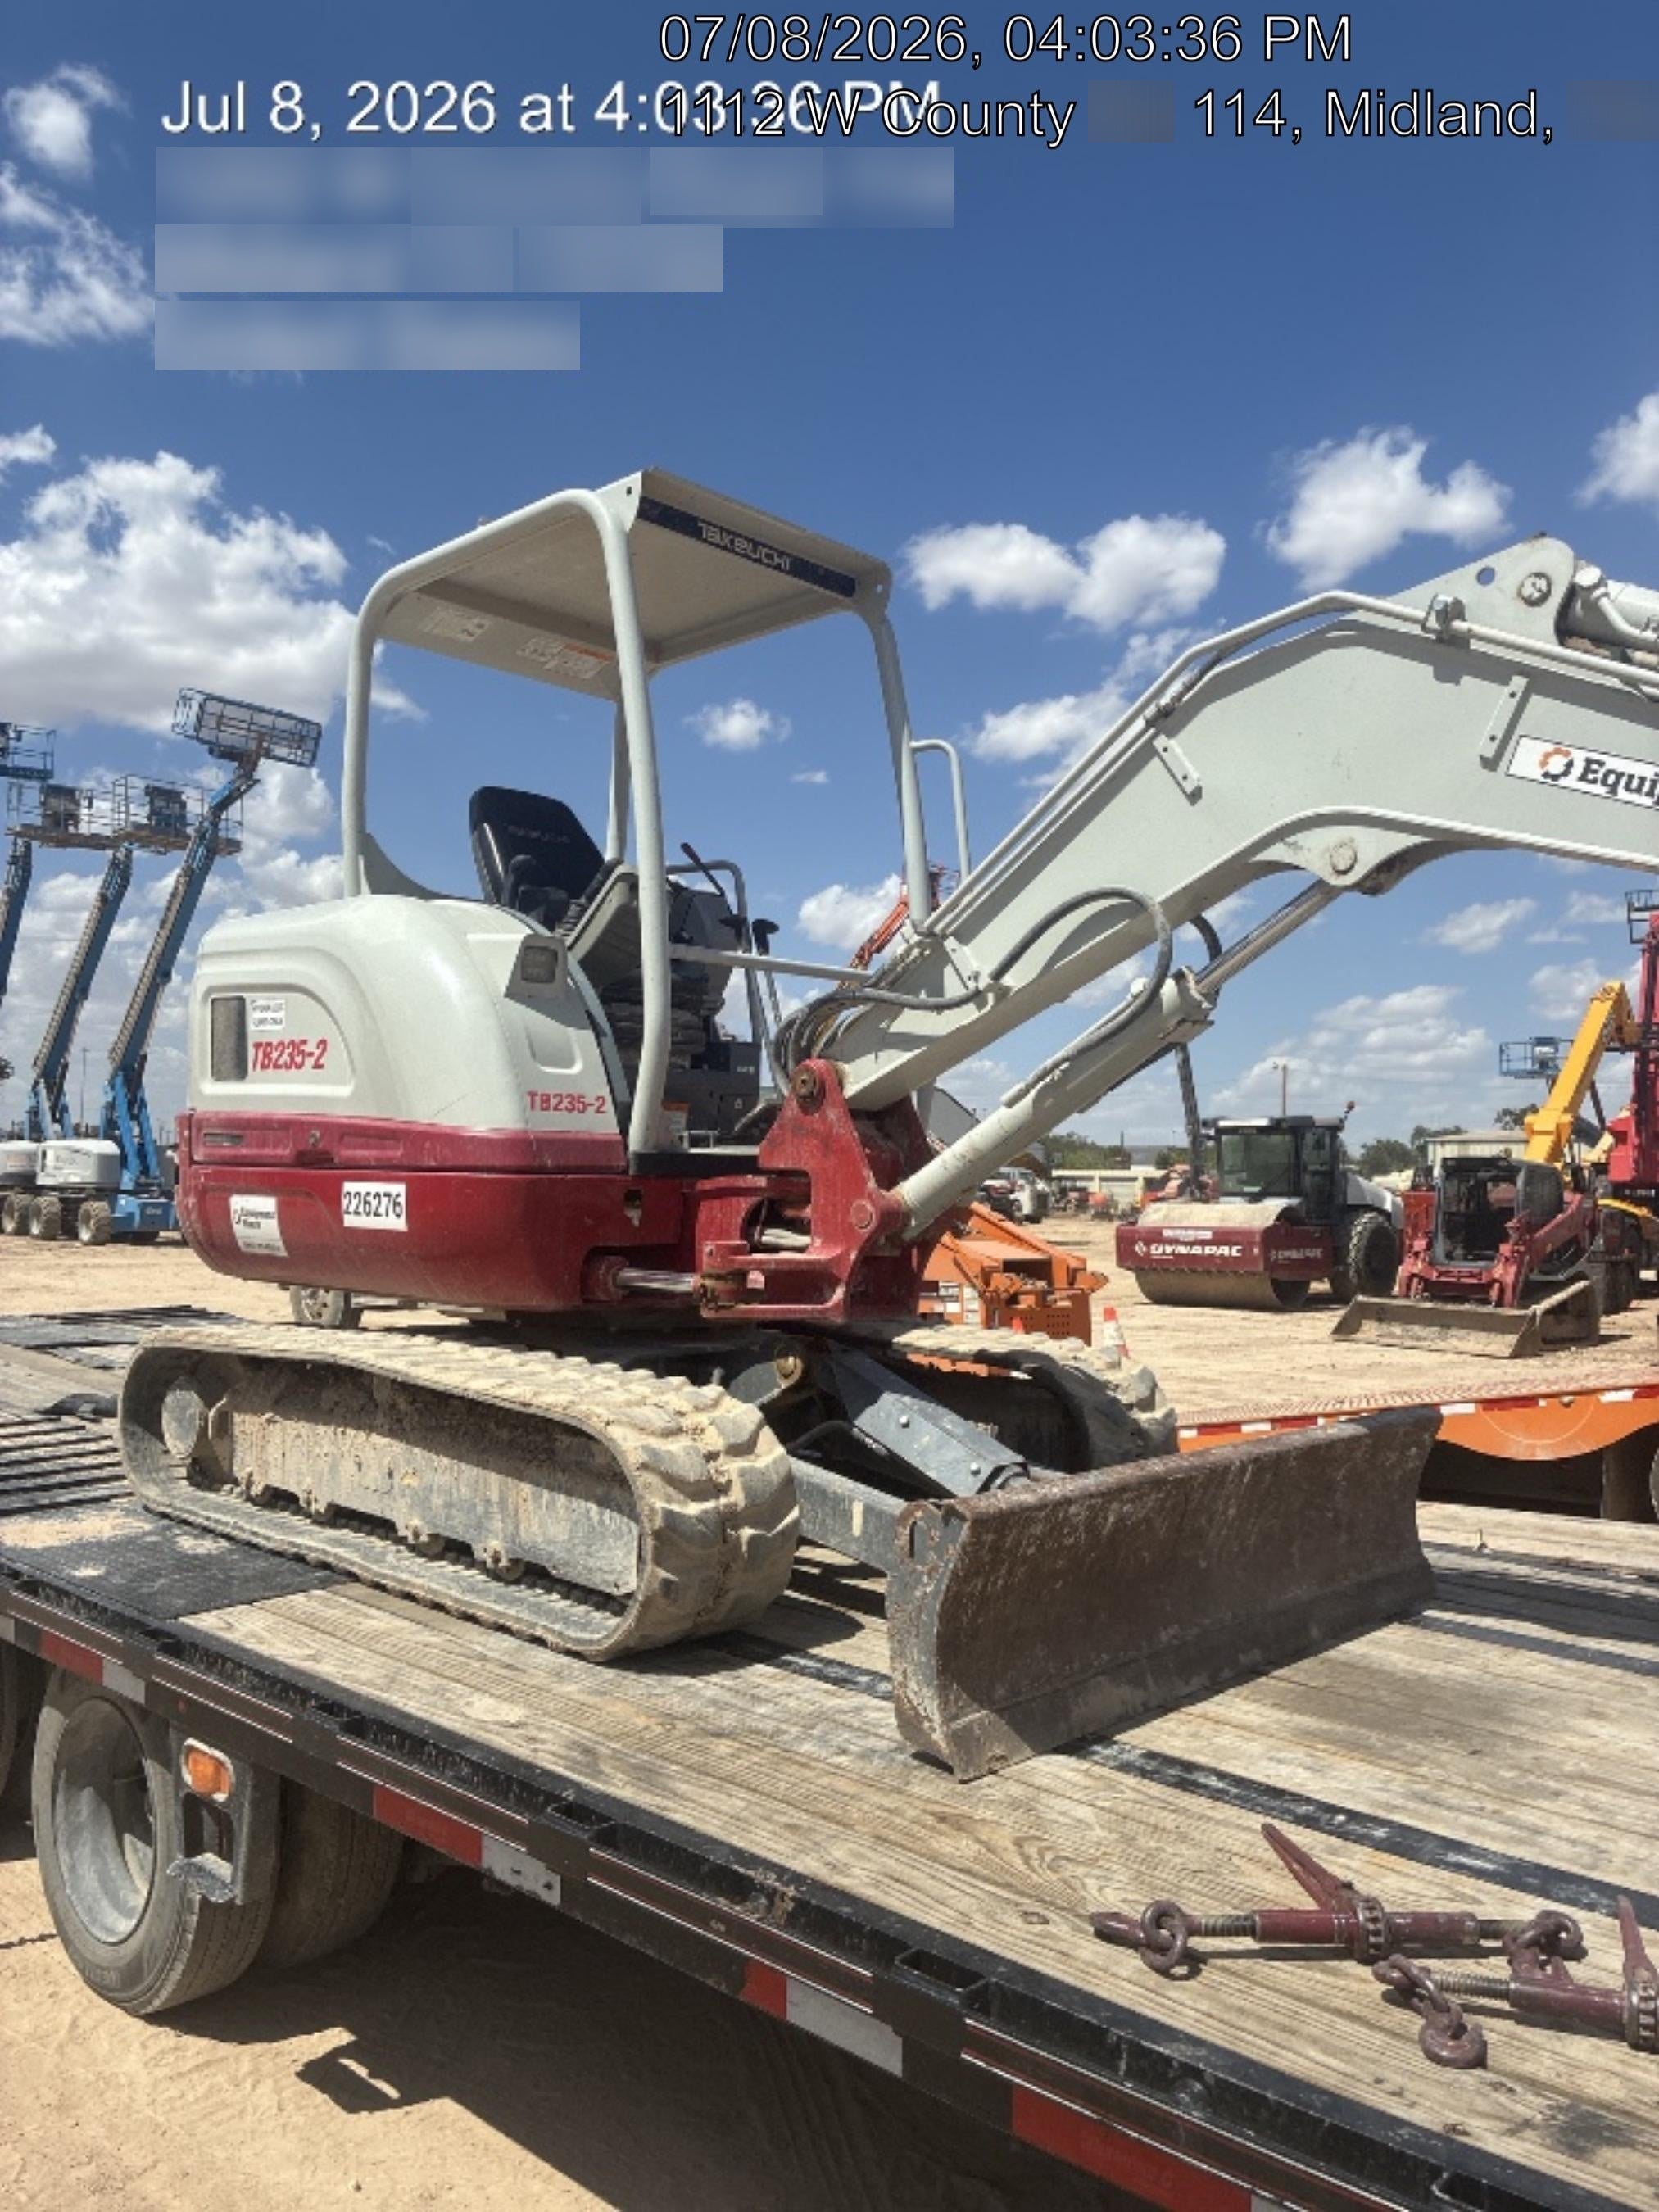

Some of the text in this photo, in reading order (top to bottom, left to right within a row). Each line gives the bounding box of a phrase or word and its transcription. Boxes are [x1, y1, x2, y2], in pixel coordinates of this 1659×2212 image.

[1577, 757, 1659, 805] Equi
[252, 1039, 328, 1072] TB235-2
[528, 1091, 606, 1114] TB235-2
[343, 1190, 404, 1219] 226276
